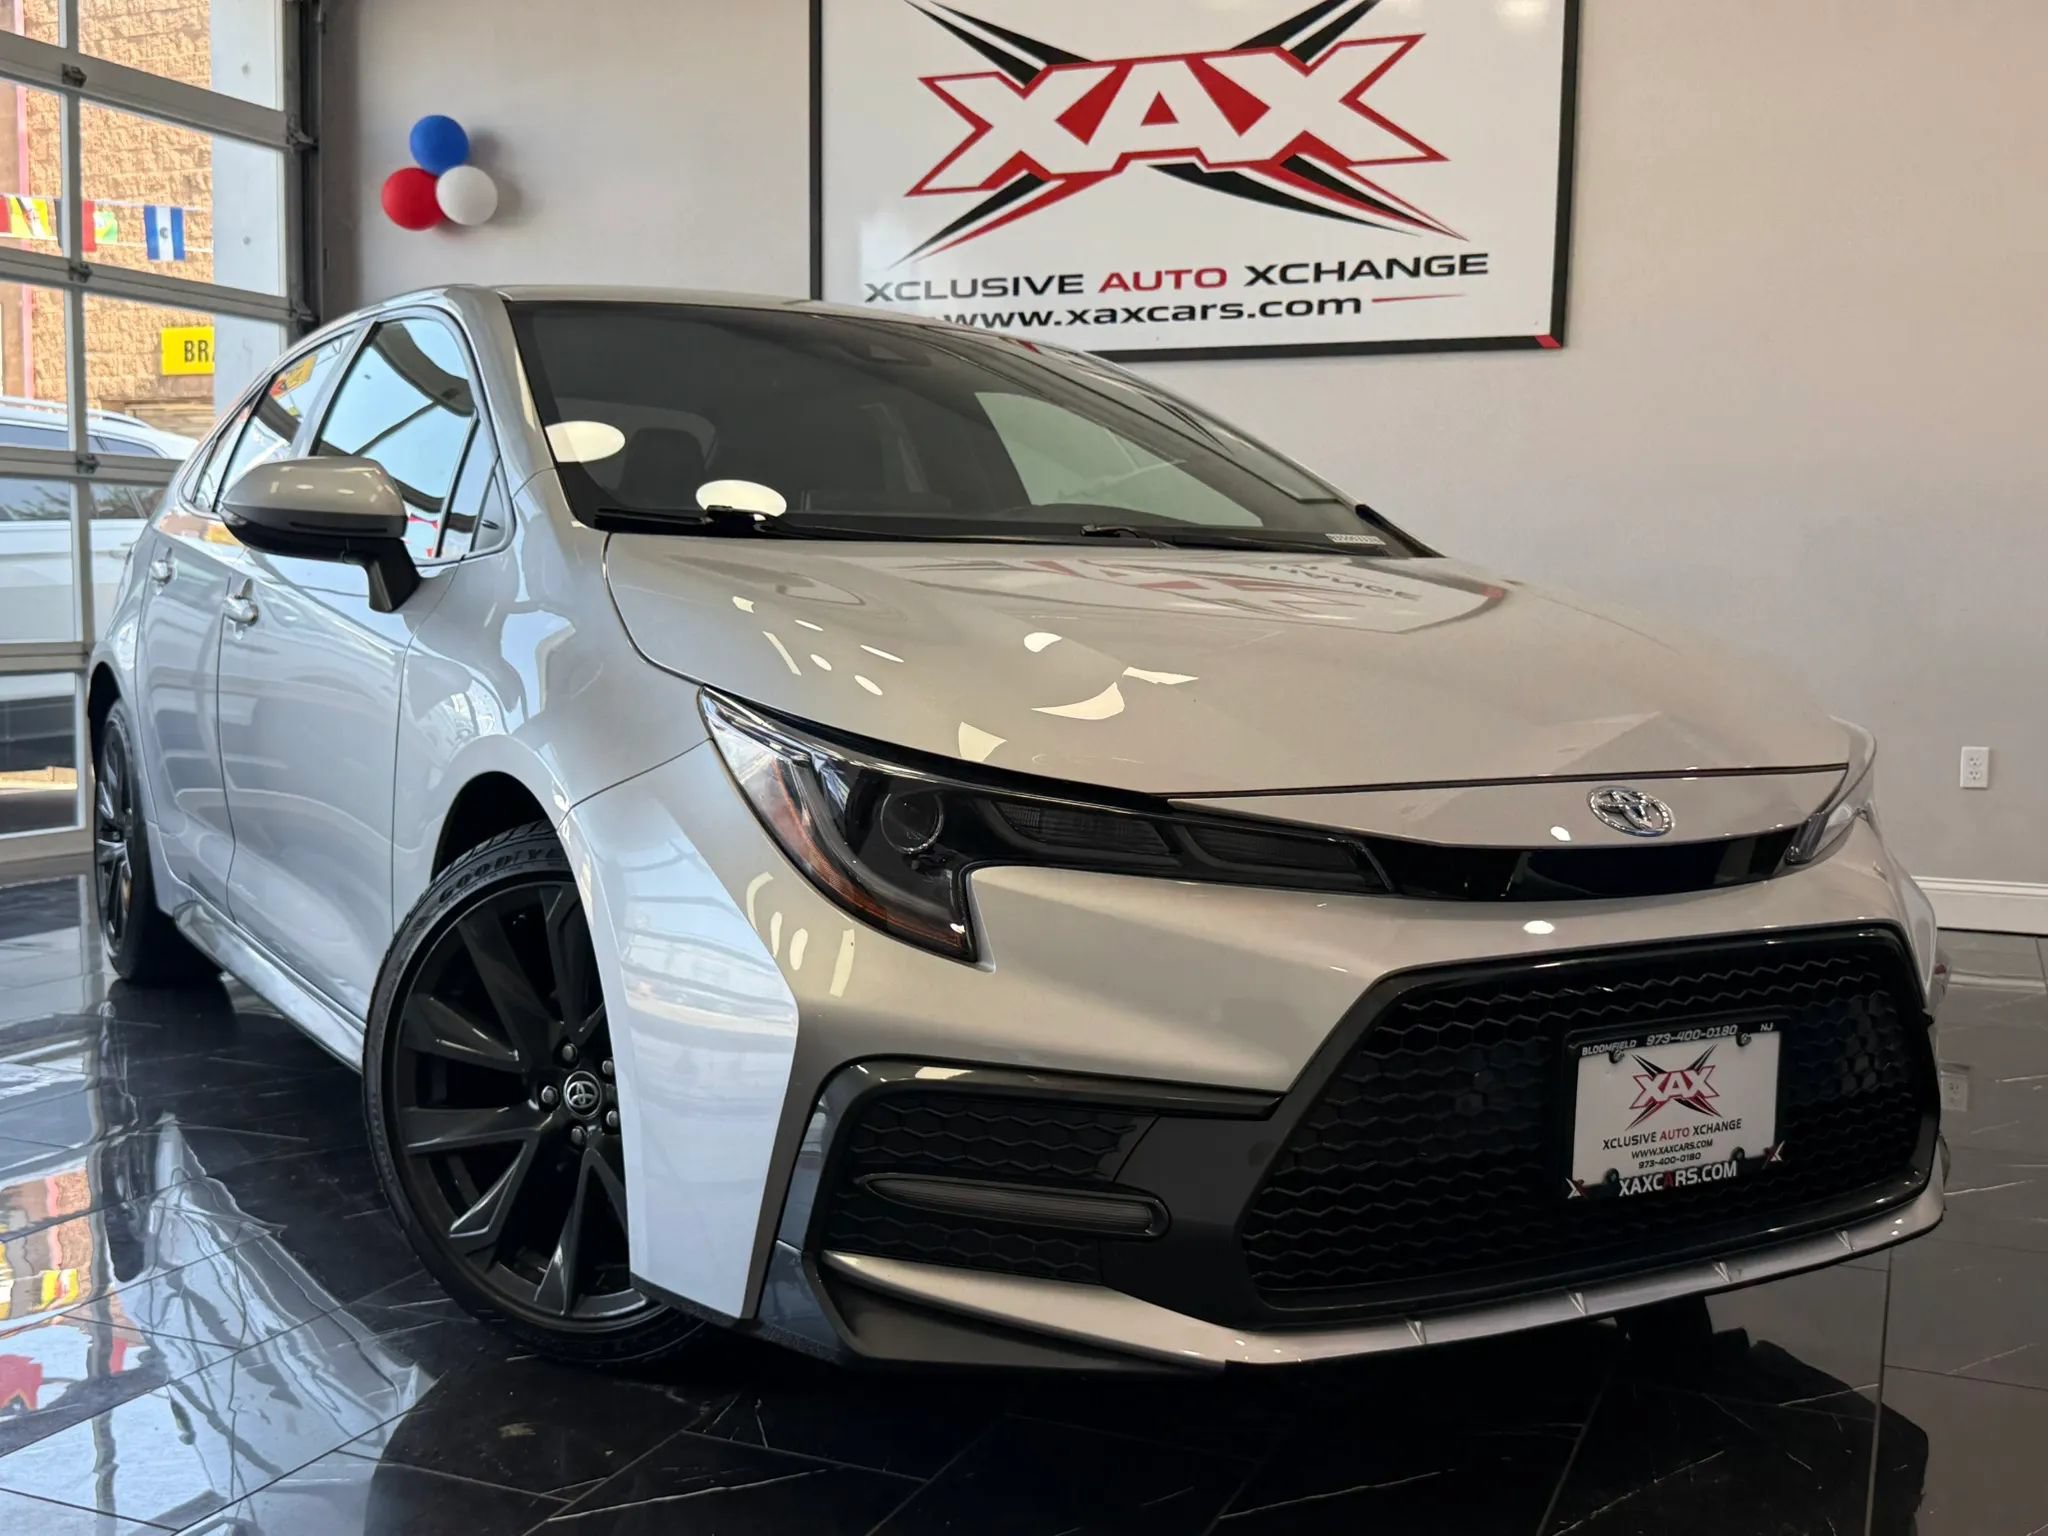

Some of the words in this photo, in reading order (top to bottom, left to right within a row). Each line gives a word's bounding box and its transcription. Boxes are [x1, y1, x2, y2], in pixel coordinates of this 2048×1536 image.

[904, 33, 1450, 197] XAX
[864, 274, 1084, 303] XCLUSIVE
[1099, 267, 1227, 294] AUTO
[1244, 253, 1489, 287] XCHANGE
[943, 297, 1361, 328] www.xaxcars.com
[183, 339, 215, 362] BR
[1582, 1039, 1637, 1057] BLOOMFIELD
[1646, 1024, 1738, 1046] 973-400-0180
[1760, 1022, 1774, 1032] NJ
[1629, 1065, 1720, 1109] XAX
[1602, 1132, 1657, 1150] XCLUSIVE
[1659, 1127, 1690, 1142] AUTO
[1692, 1118, 1742, 1136] XCHANGE
[1631, 1139, 1713, 1159] WWW.XAXCARS.COM
[1638, 1152, 1701, 1169] 973-400-0180
[1618, 1160, 1738, 1197] XAXCARS.COM
